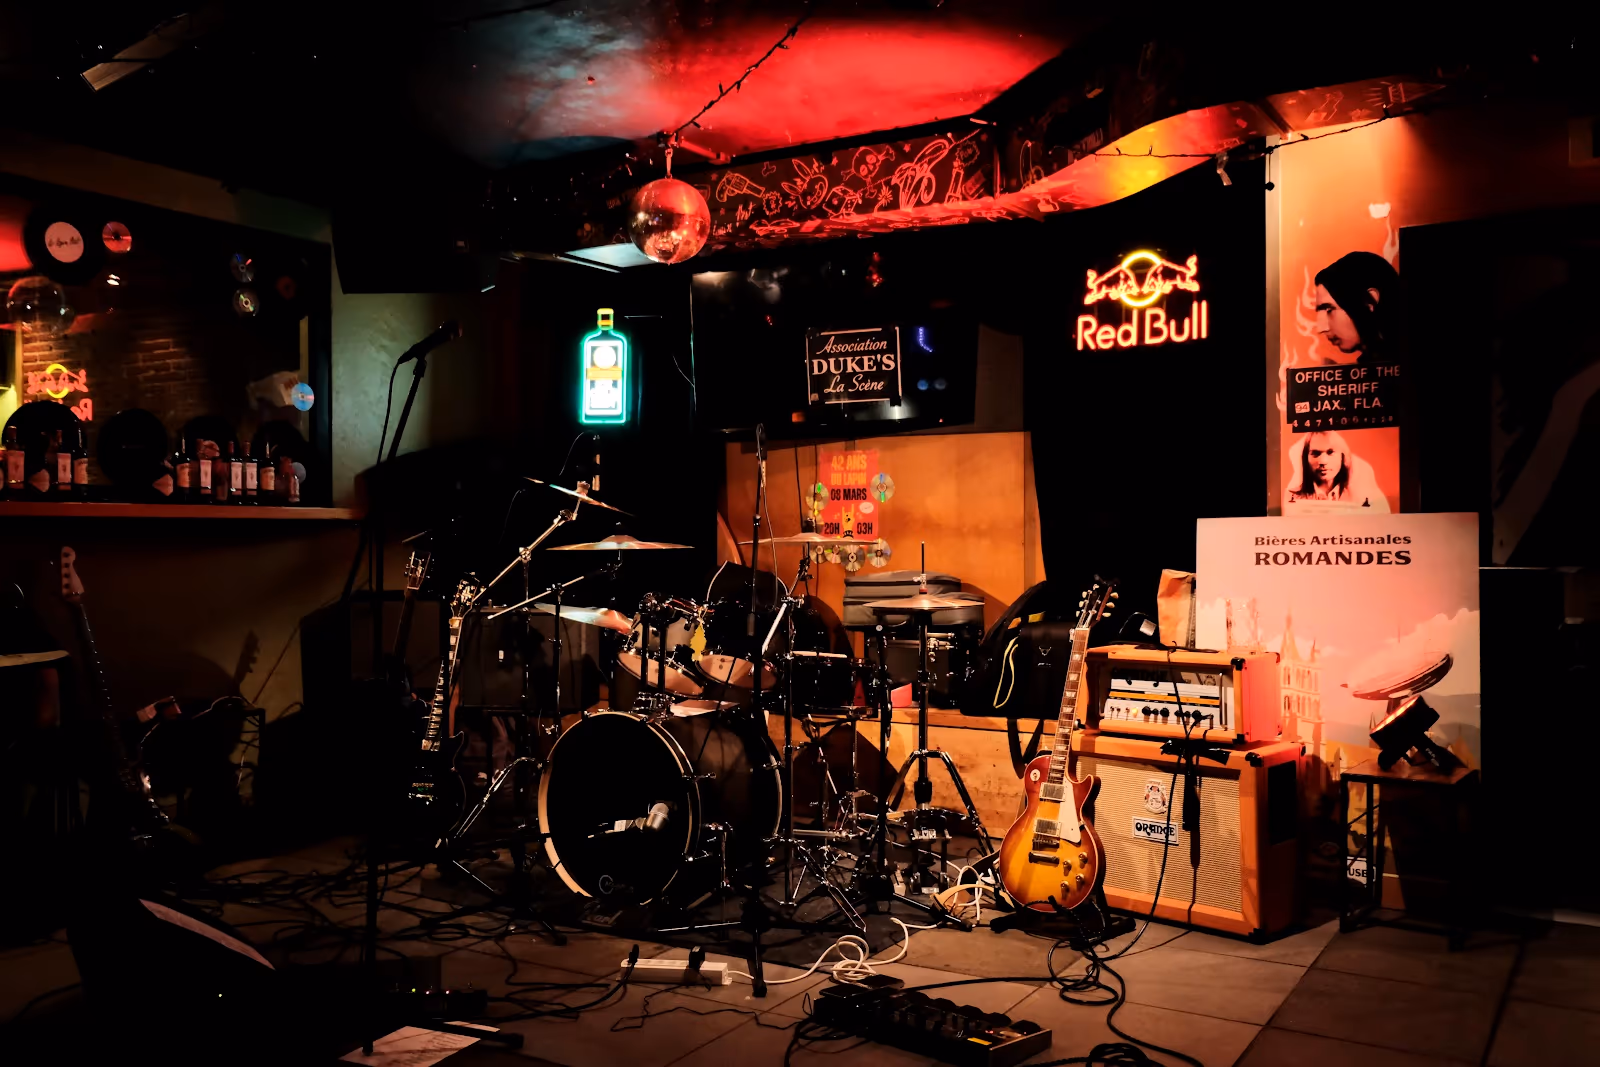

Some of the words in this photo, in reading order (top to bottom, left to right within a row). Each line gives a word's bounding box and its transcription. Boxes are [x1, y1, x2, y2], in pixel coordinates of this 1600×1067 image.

[1076, 307, 1138, 351] Red
[1144, 299, 1208, 345] Bull
[816, 336, 887, 354] Association
[812, 354, 896, 375] DUKE'S
[1295, 369, 1343, 384] OFFICE
[1350, 367, 1368, 380] OF
[1376, 365, 1400, 378] THE
[824, 375, 845, 393] La
[848, 374, 884, 392] Scène
[1317, 382, 1379, 397] SHERIFF
[1353, 397, 1384, 410] FLA.
[831, 455, 844, 471] 42
[846, 453, 867, 471] ANS
[830, 488, 841, 501] 08
[843, 488, 867, 501] MARS
[824, 522, 840, 535] 20H
[857, 522, 873, 535] 03H
[1254, 536, 1306, 546] Bières
[1310, 534, 1412, 546] Artisanales
[1254, 550, 1412, 566] ROMANDES
